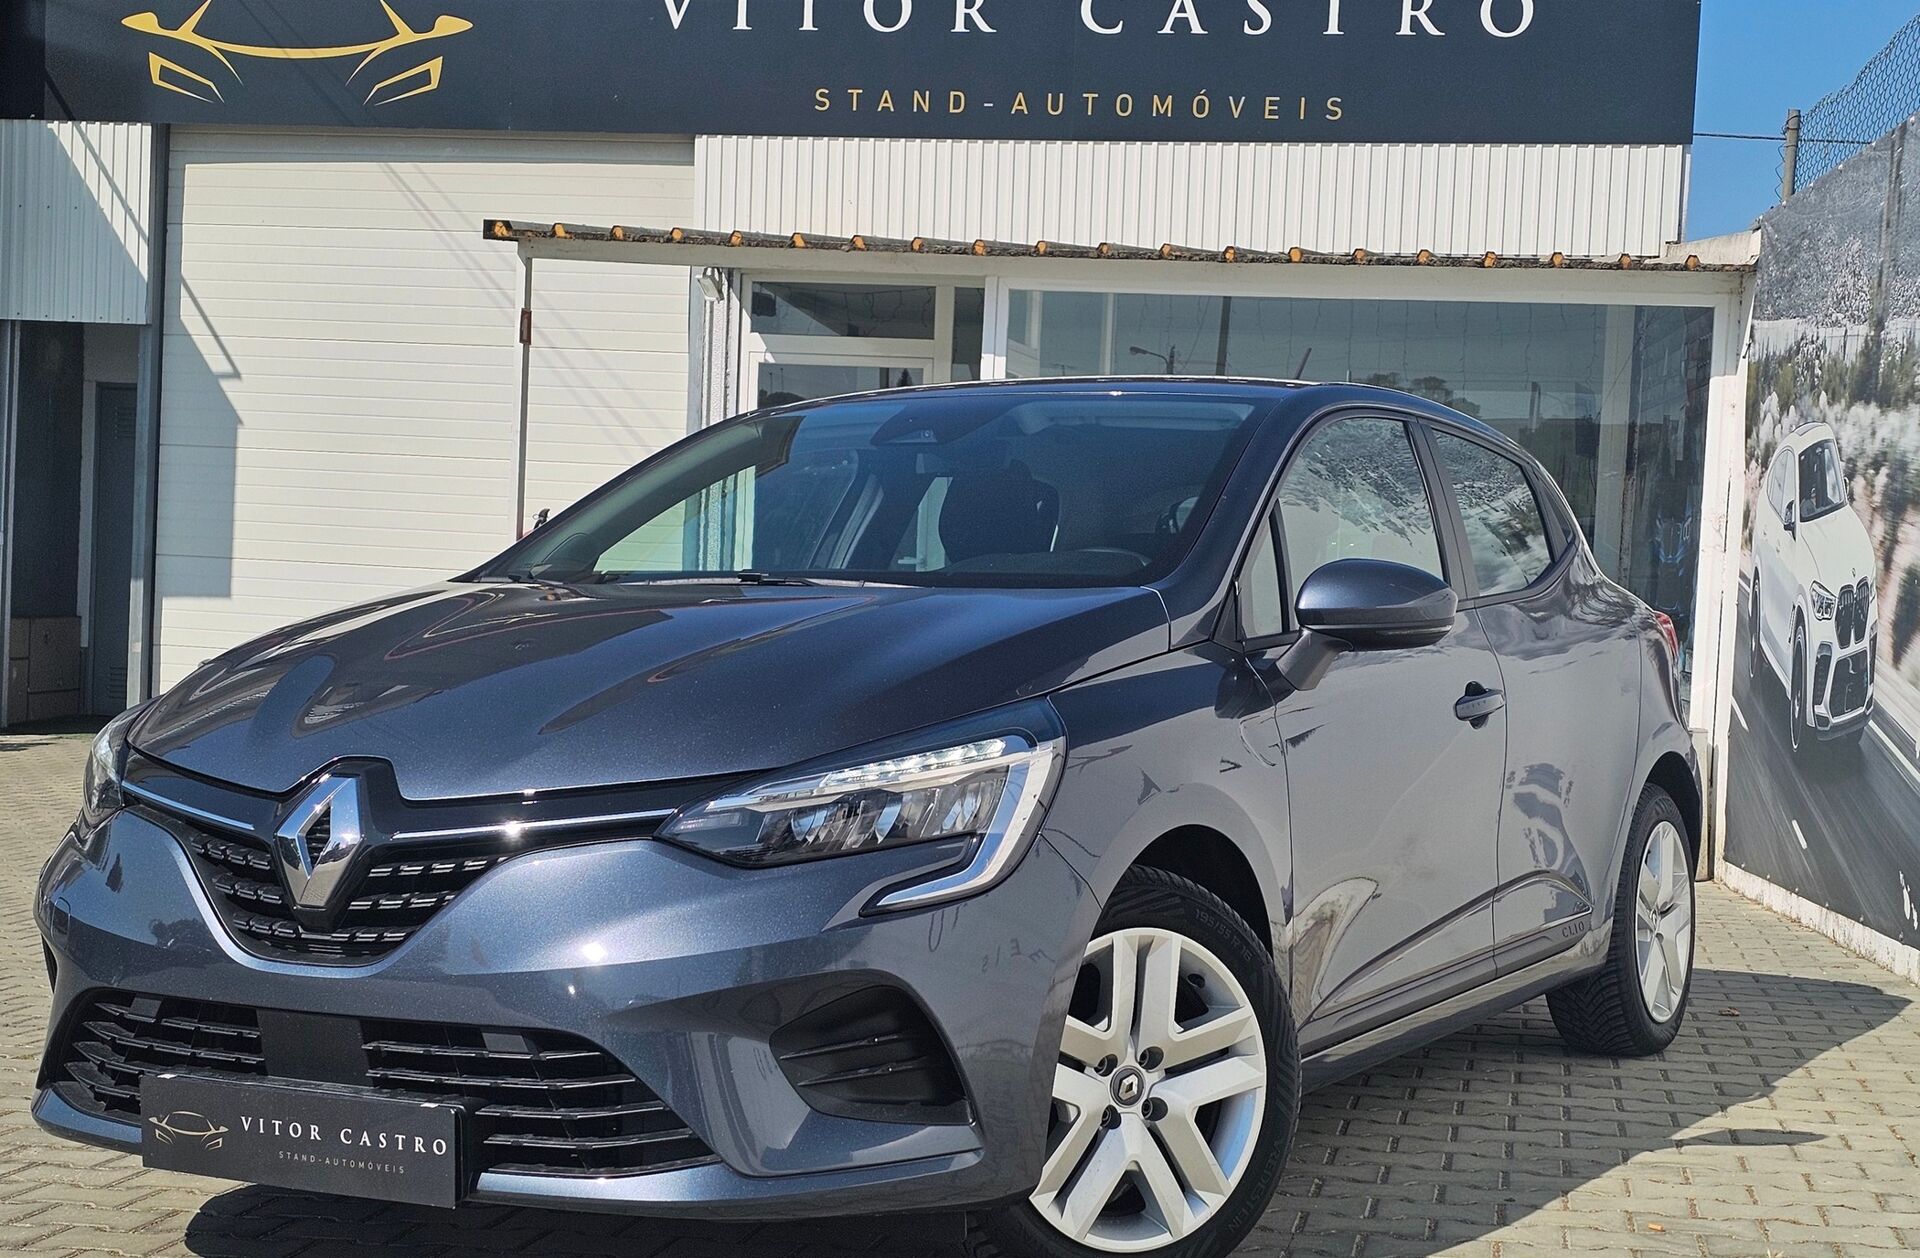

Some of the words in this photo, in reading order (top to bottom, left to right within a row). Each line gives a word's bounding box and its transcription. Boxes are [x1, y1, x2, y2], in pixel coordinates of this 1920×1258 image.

[814, 88, 1343, 121] STAND-AUTOMÓVEIS
[1562, 921, 1585, 938] CLIO
[240, 1115, 322, 1141] VITOR
[339, 1127, 447, 1156] CASTRO
[278, 1150, 405, 1175] STAND-AUTOMÓVEIS
[1227, 1141, 1283, 1234] VREDESTEIN
